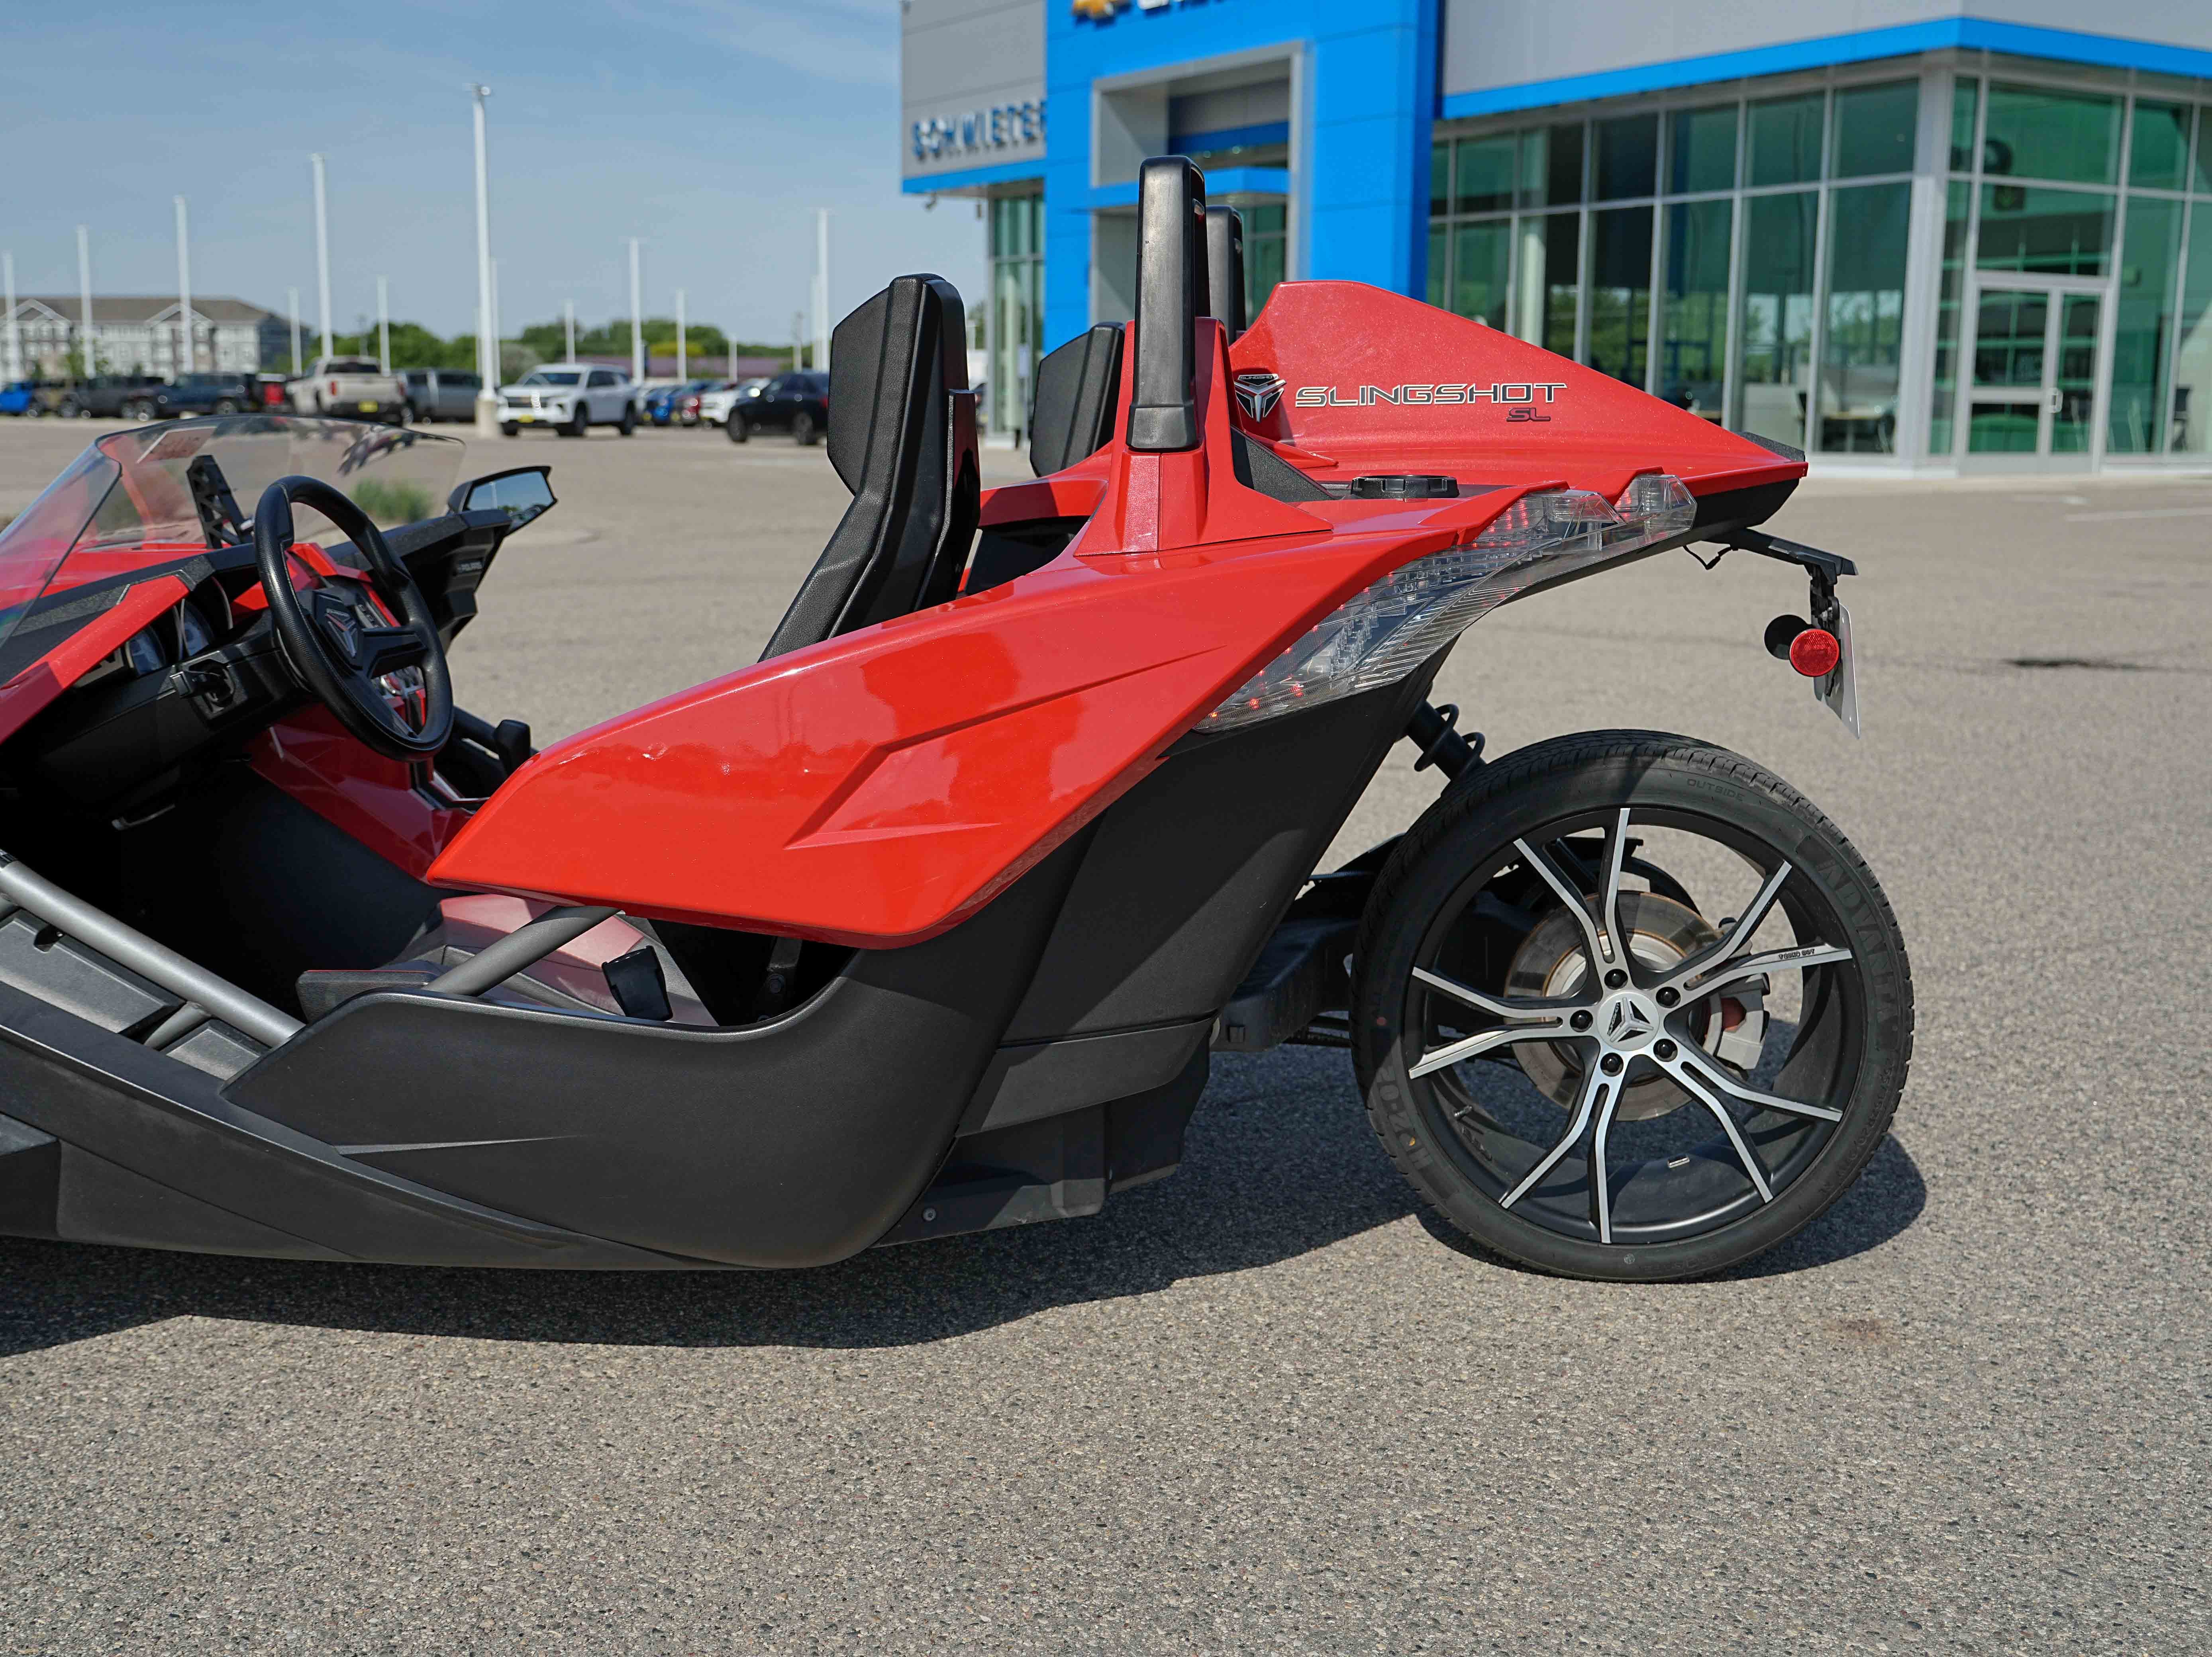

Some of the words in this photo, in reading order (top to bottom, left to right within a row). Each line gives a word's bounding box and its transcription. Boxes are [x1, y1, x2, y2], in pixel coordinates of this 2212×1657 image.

[1295, 383, 1567, 407] SLINGSHOT
[1506, 407, 1551, 422] SL
[1686, 777, 1746, 802] OUTSIDE
[1816, 856, 1899, 1024] ADVANTA
